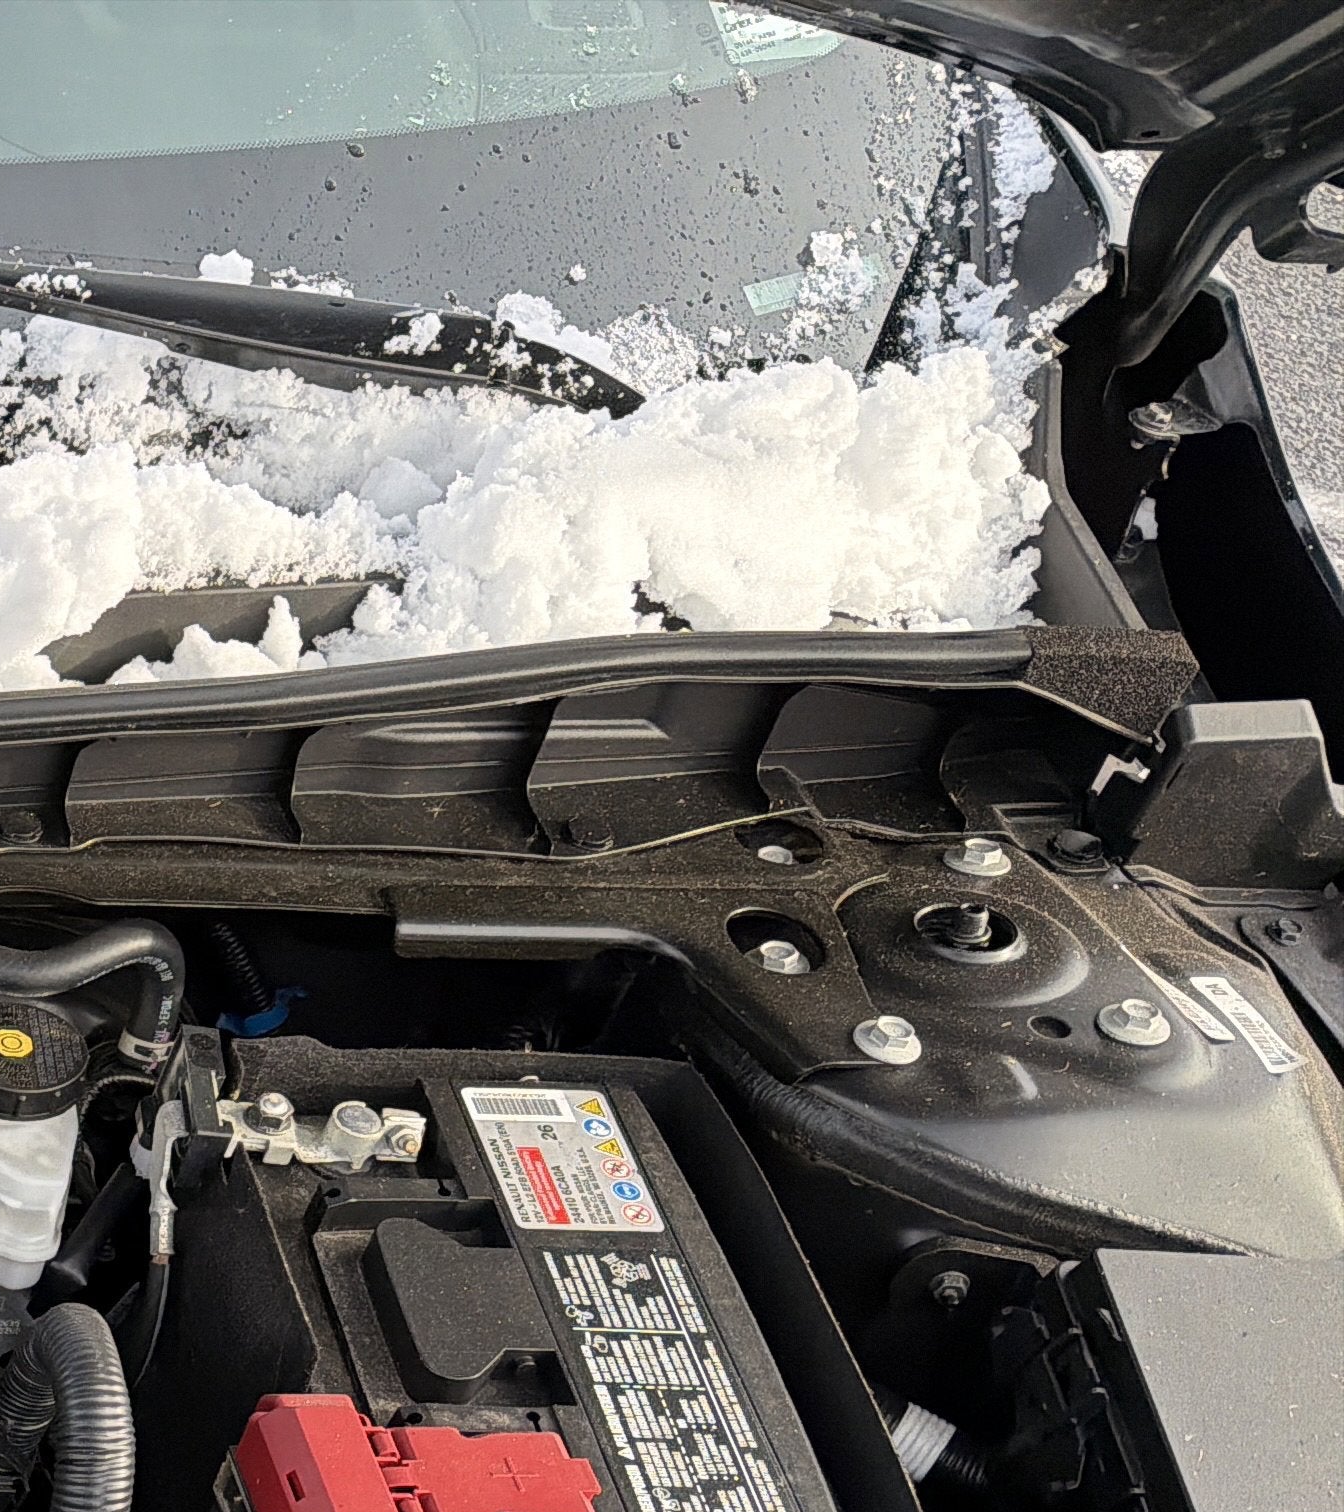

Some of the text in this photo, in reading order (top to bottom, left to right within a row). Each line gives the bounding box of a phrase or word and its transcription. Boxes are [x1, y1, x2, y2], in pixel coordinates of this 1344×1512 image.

[536, 1124, 558, 1140] 26
[487, 1138, 531, 1222] RENAULT NISSAN
